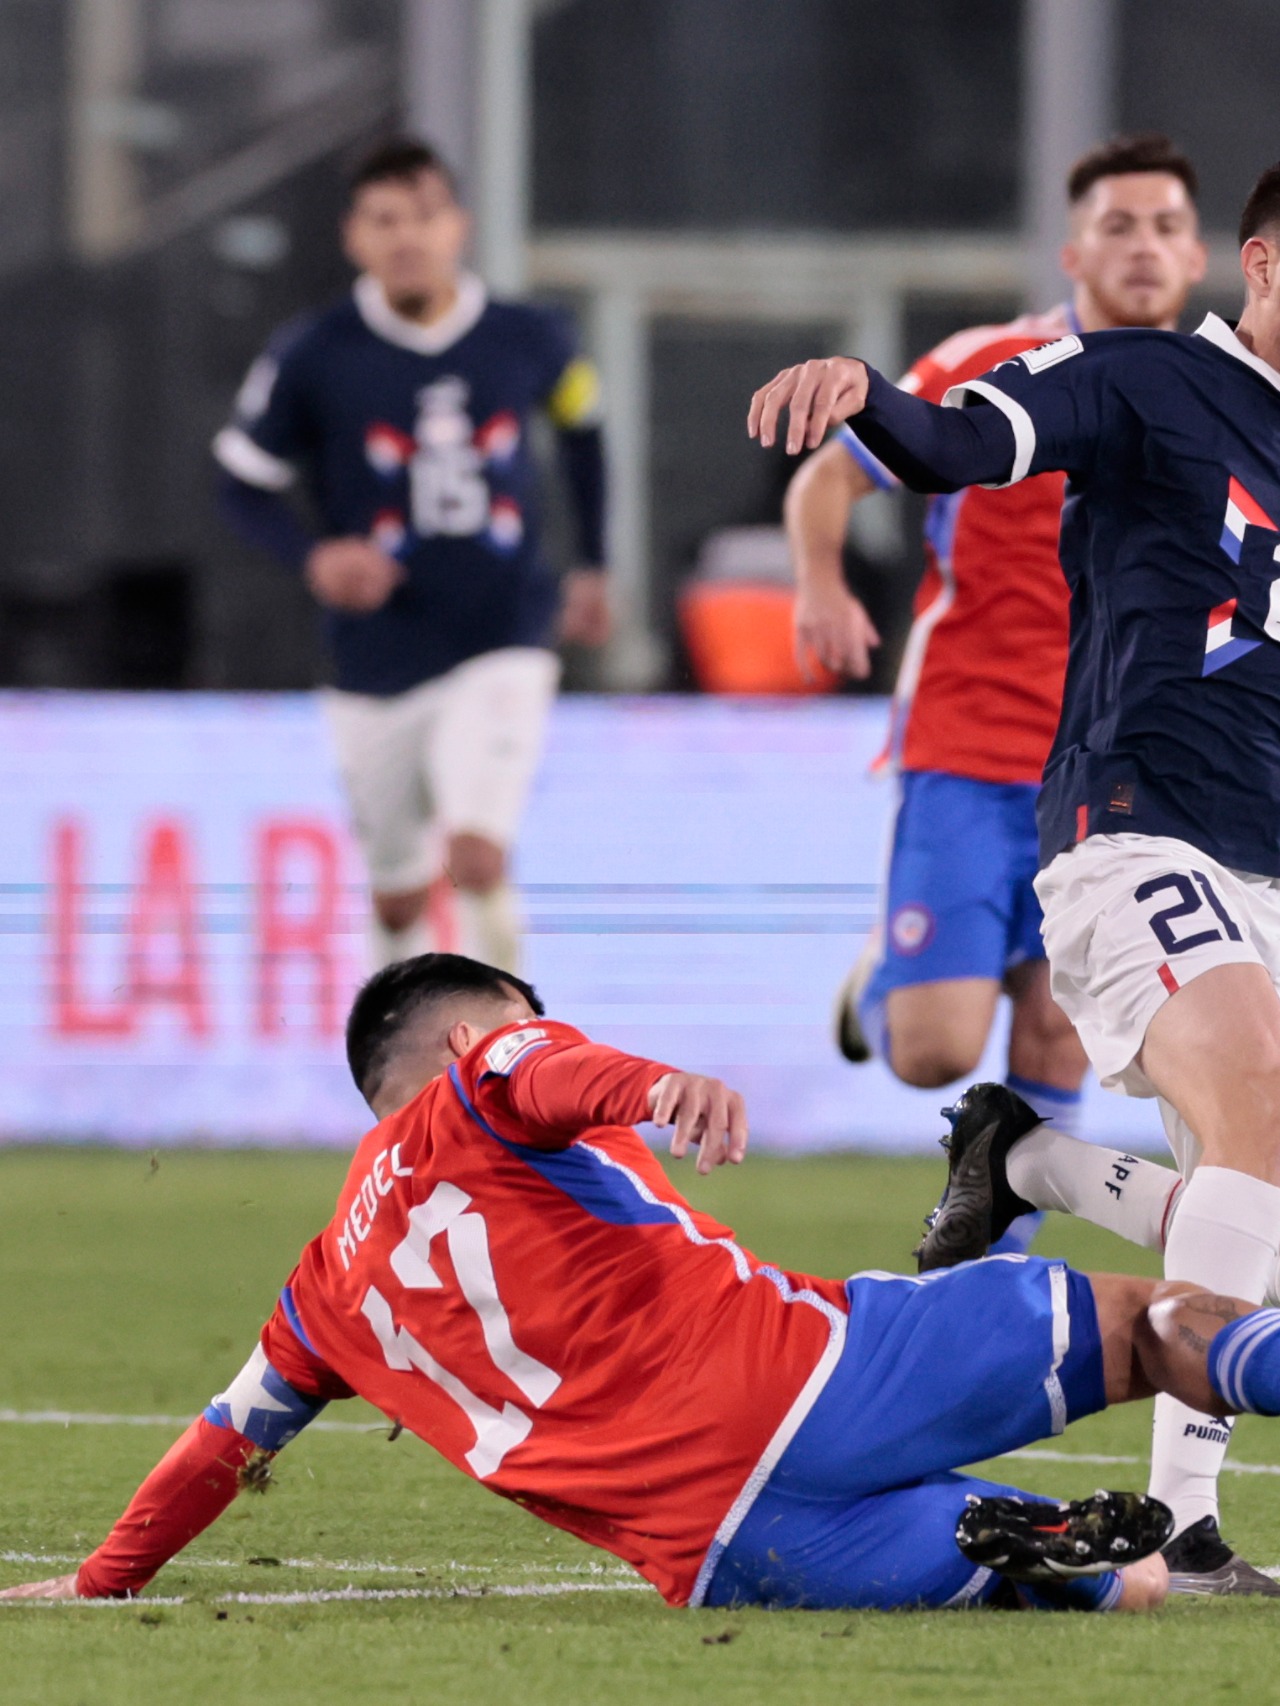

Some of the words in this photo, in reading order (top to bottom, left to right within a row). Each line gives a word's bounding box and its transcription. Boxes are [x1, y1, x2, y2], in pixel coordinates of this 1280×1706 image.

[50, 814, 208, 1038] LA
[1133, 868, 1244, 956] 21
[337, 1142, 413, 1272] MEDEL
[1104, 1154, 1139, 1200] APF
[360, 1181, 562, 1479] 17
[1183, 1423, 1230, 1445] PUMA
